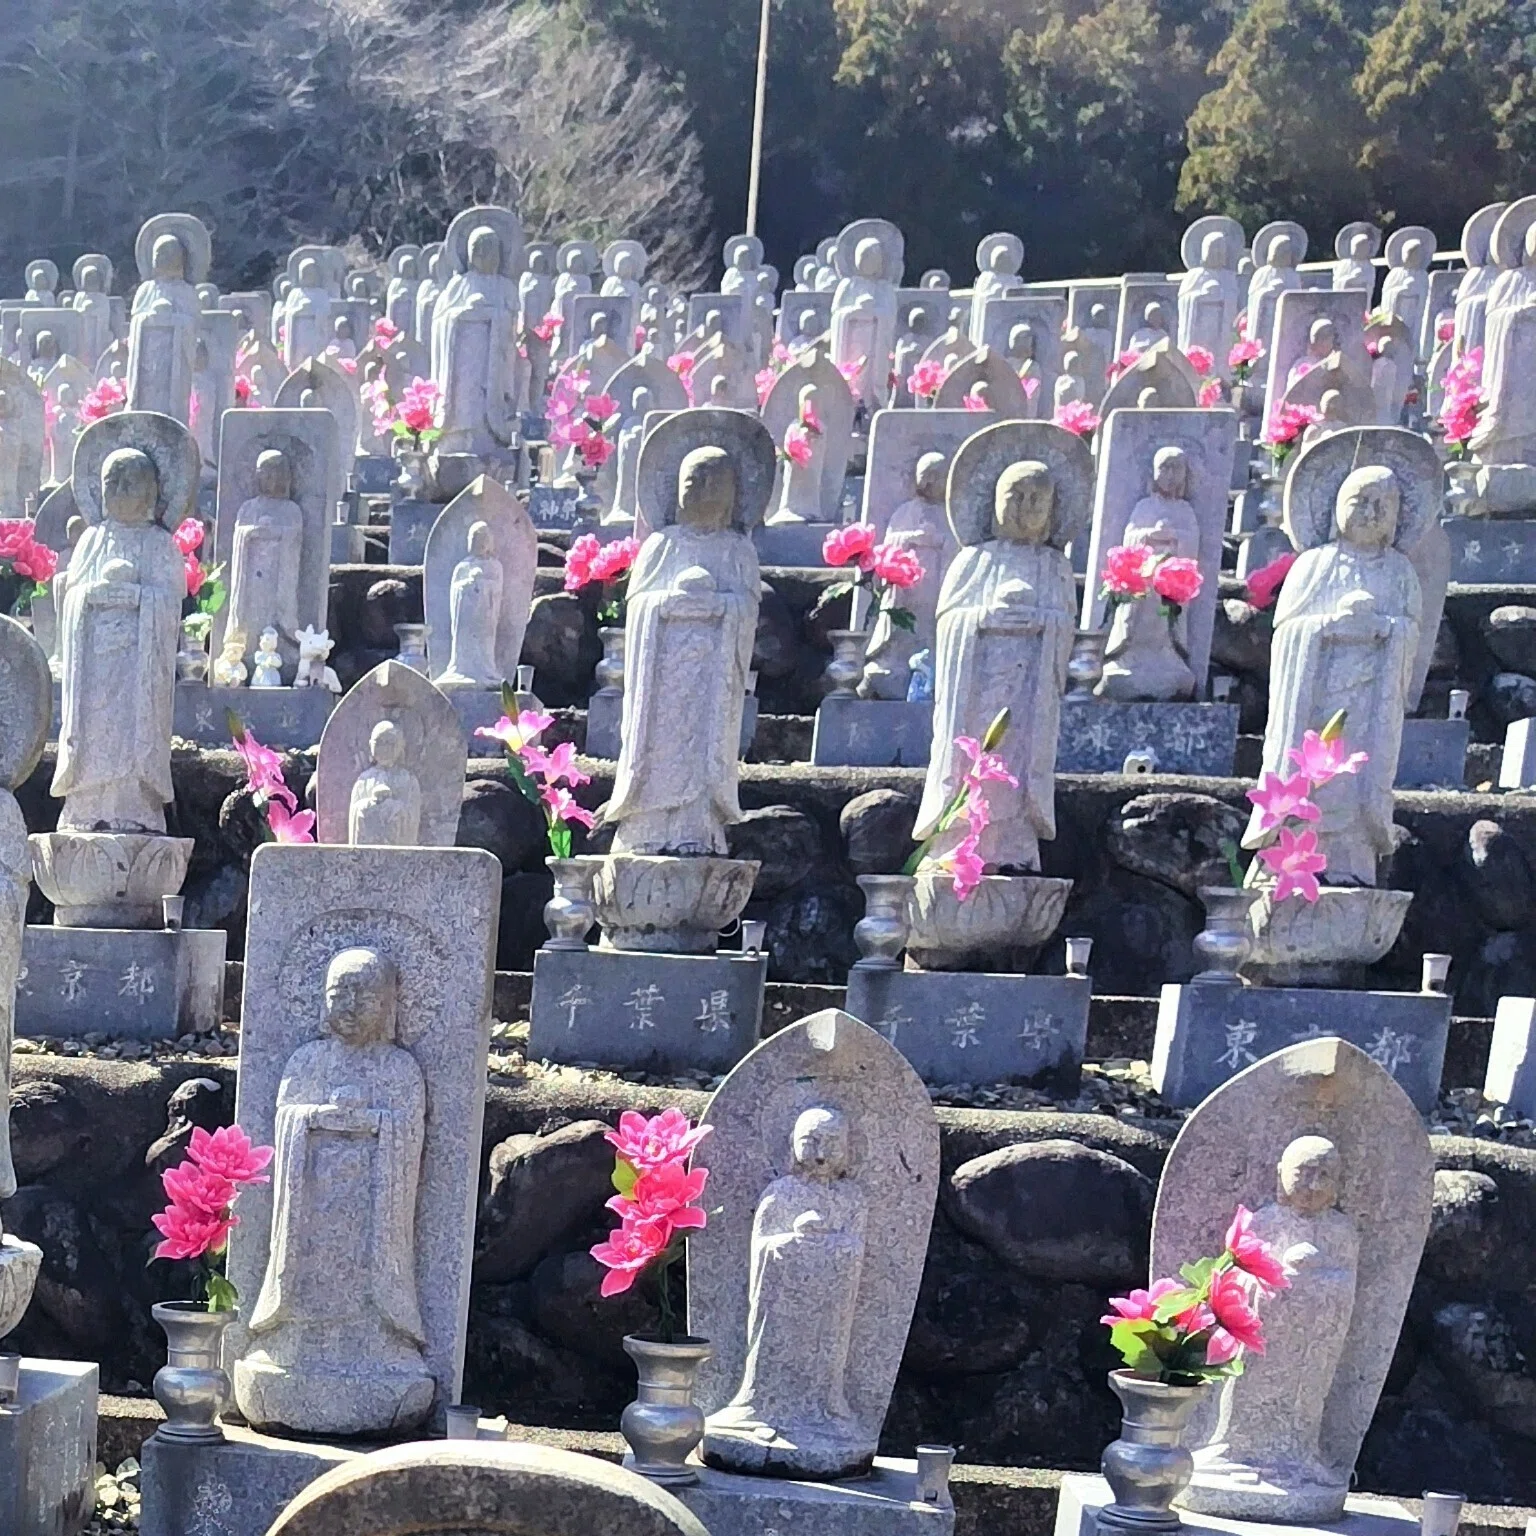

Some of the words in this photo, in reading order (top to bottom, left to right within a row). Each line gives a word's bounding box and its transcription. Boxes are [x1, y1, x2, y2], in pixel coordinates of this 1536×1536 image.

[557, 984, 731, 1033] 千葉県
[1216, 1019, 1419, 1076] 東都
